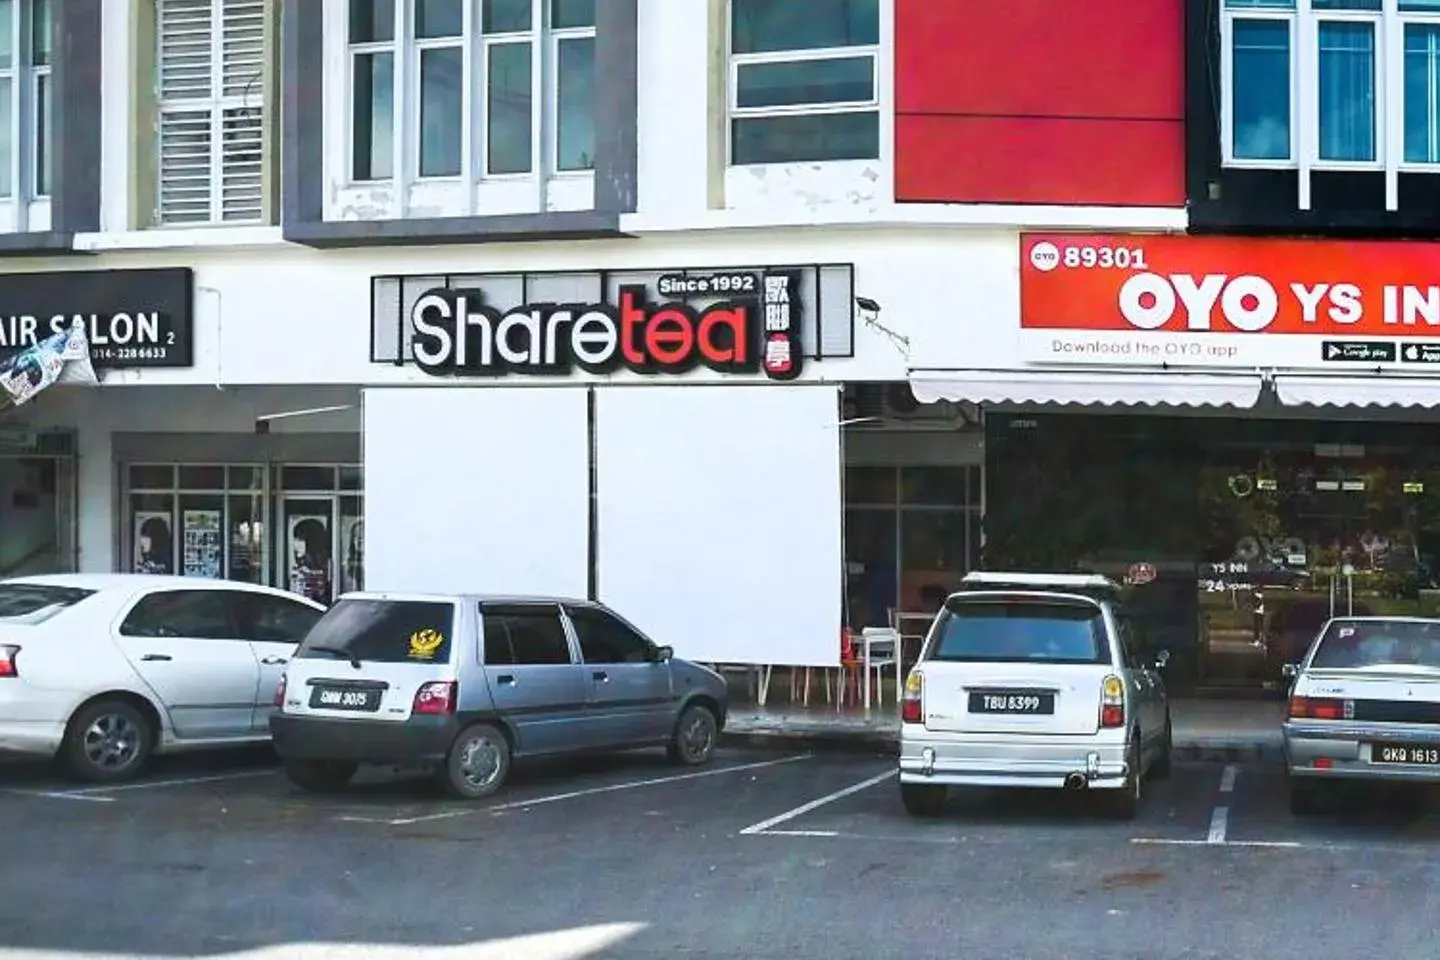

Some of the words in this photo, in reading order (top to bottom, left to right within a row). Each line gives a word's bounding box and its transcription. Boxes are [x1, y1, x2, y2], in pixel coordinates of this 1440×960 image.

[1063, 246, 1149, 269] 89301
[659, 278, 709, 292] Since
[710, 276, 754, 291] 1992
[1118, 271, 1279, 331] OYO
[1290, 283, 1362, 323] YS
[412, 290, 746, 366] Sharetea
[1052, 340, 1131, 354] Download
[1136, 342, 1160, 355] the
[1165, 343, 1202, 355] OYO
[1207, 345, 1238, 357] app
[1411, 748, 1439, 763] 1613
